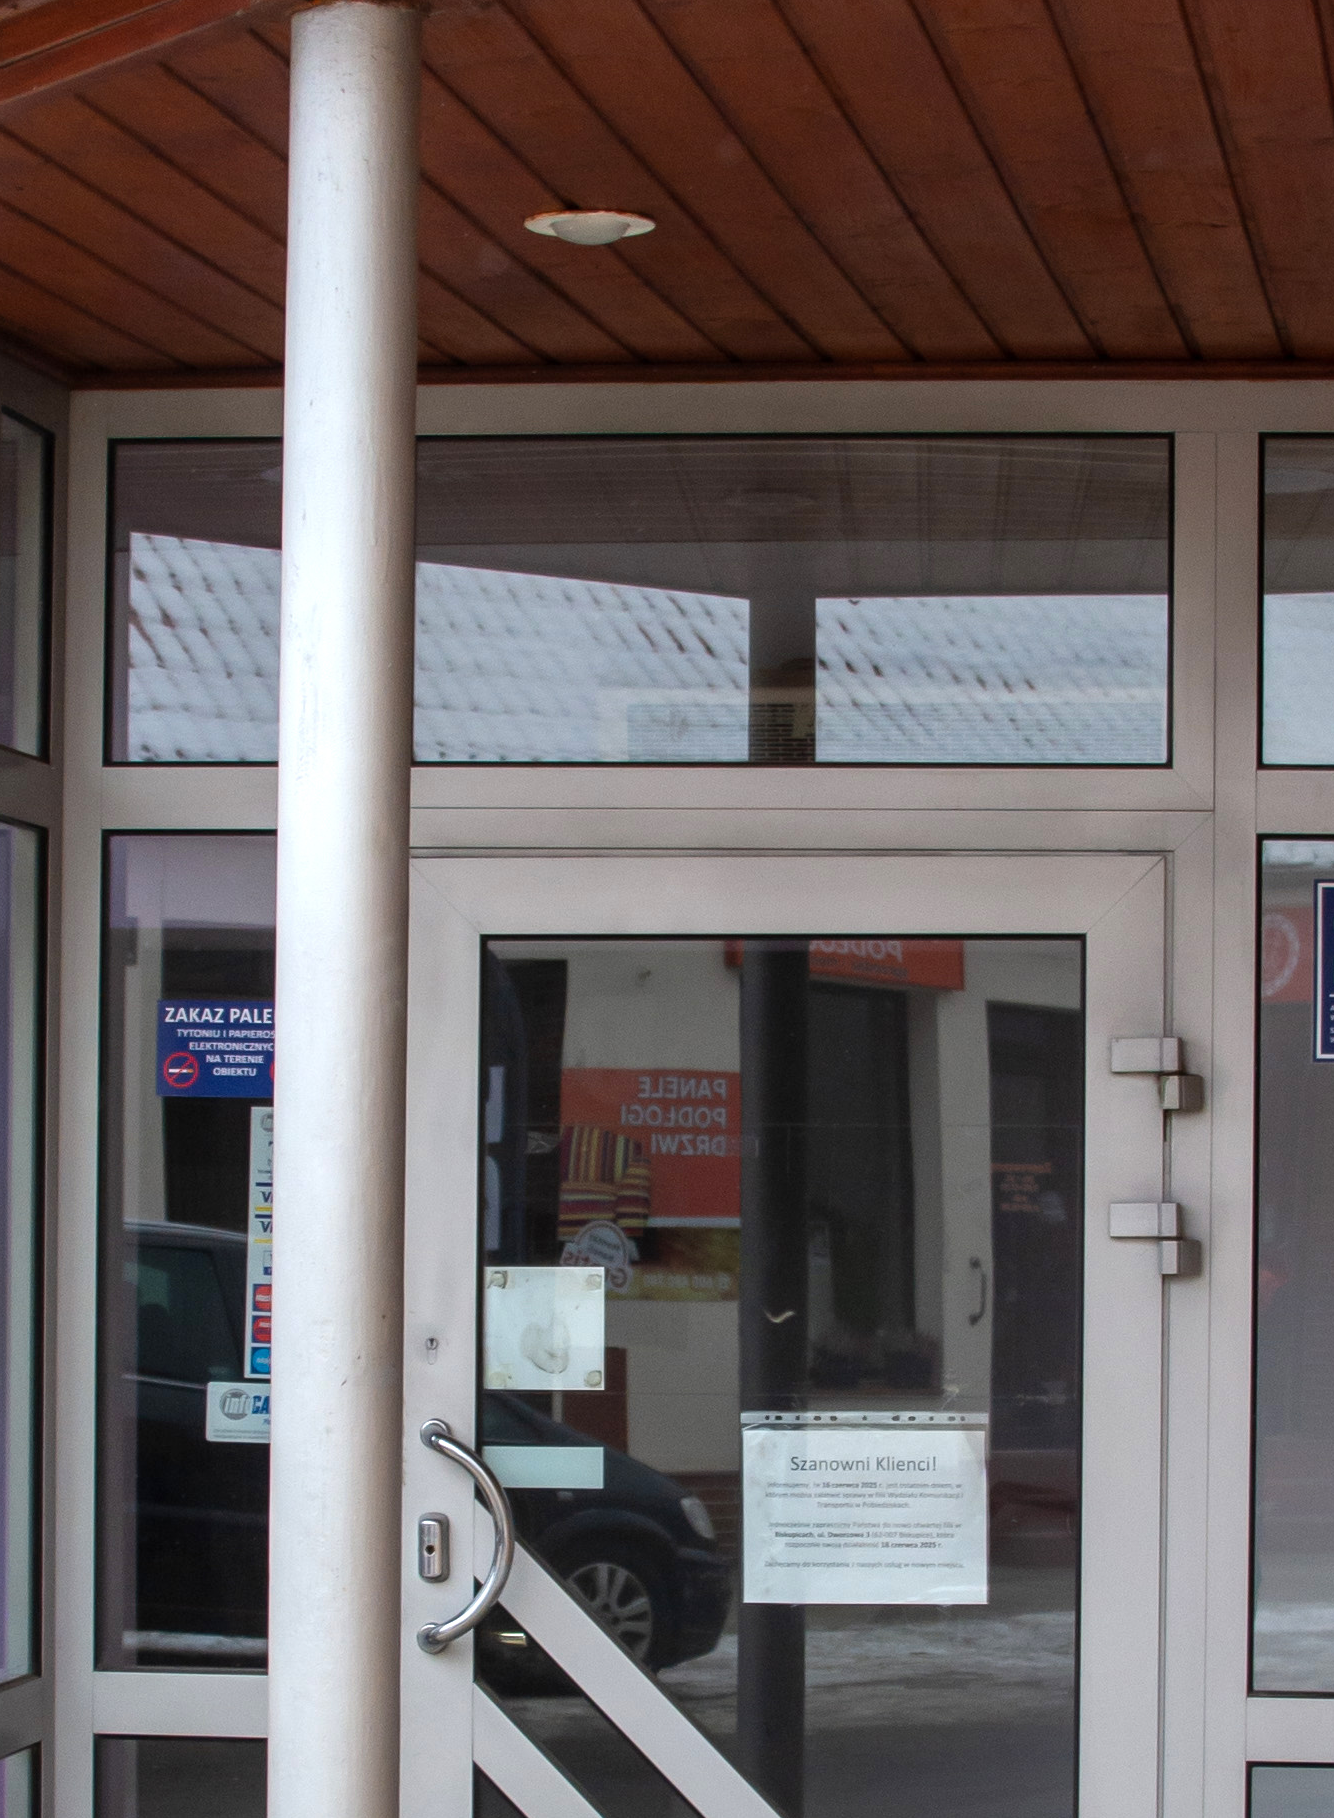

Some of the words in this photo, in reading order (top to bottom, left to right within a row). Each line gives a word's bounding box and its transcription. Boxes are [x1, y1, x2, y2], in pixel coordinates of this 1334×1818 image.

[165, 1007, 224, 1023] ZAKAZ
[230, 1008, 273, 1024] PALE
[176, 1029, 220, 1038] TYTONIU
[229, 1030, 275, 1039] PAPIEROS
[189, 1042, 274, 1051] ELEKTRONICZNYC
[206, 1054, 222, 1063] NA
[224, 1055, 264, 1064] TERENIE
[213, 1067, 257, 1077] OBIEKTU
[790, 1456, 871, 1471] Szanowni
[876, 1456, 937, 1471] Klienci!
